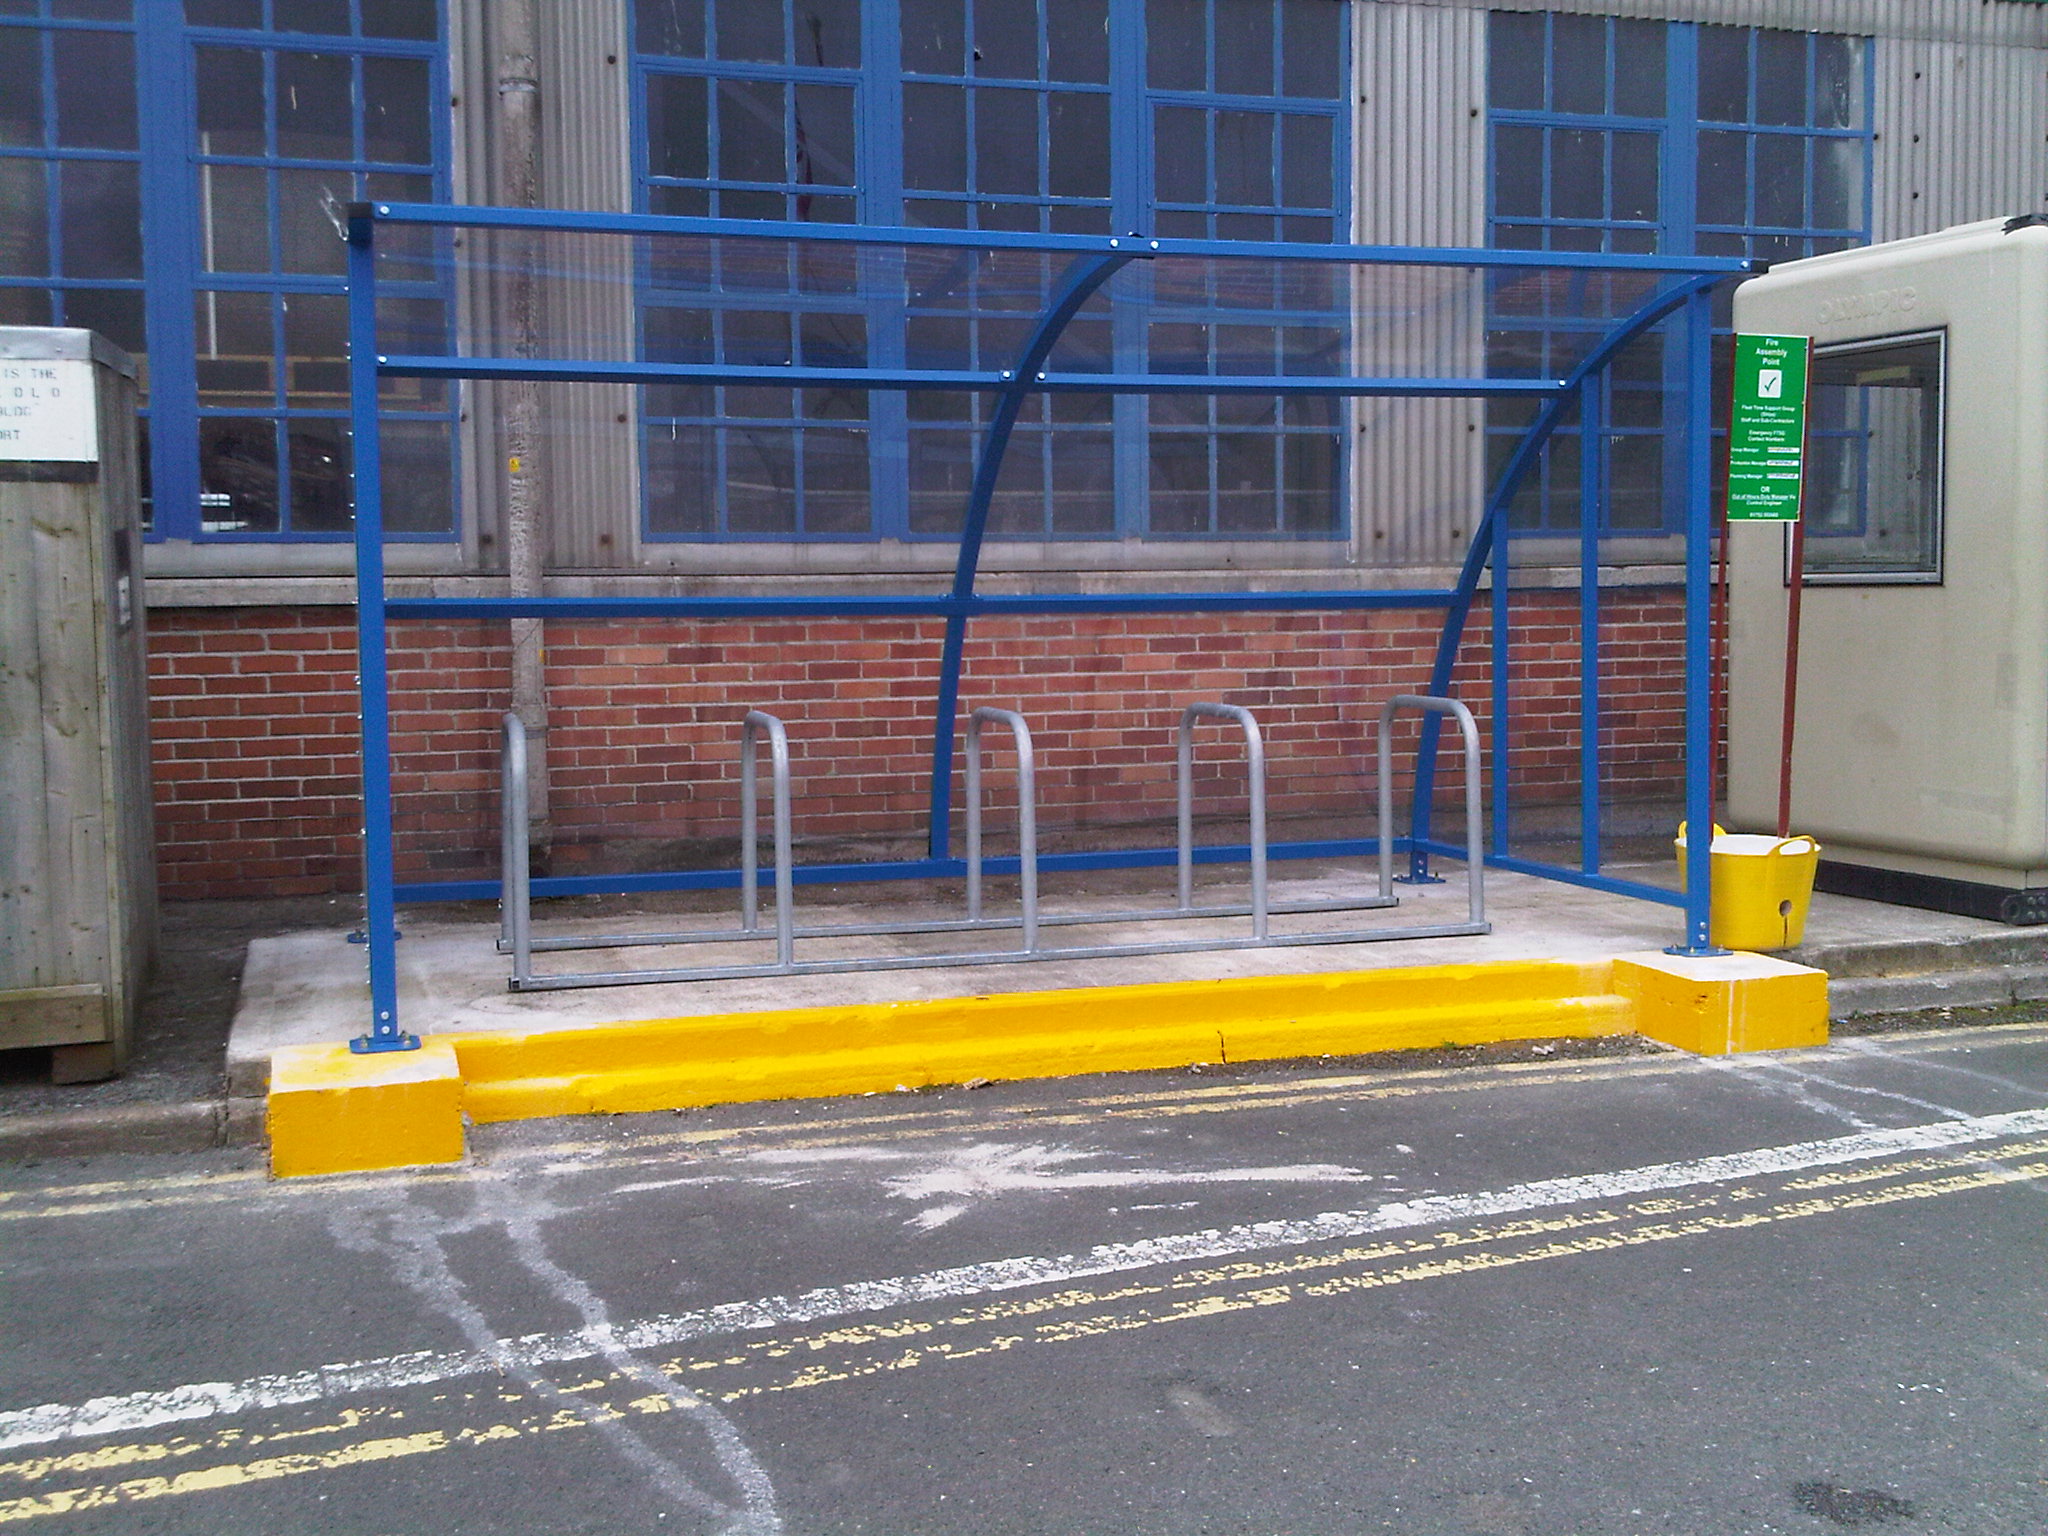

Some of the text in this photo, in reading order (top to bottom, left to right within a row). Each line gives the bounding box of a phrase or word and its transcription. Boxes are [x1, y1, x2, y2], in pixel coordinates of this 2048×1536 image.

[1815, 286, 1918, 326] OLYMPIC
[1766, 338, 1779, 346] Fire
[1756, 347, 1787, 358] Assembly
[1763, 358, 1780, 366] Point
[4, 368, 57, 379] IS THE
